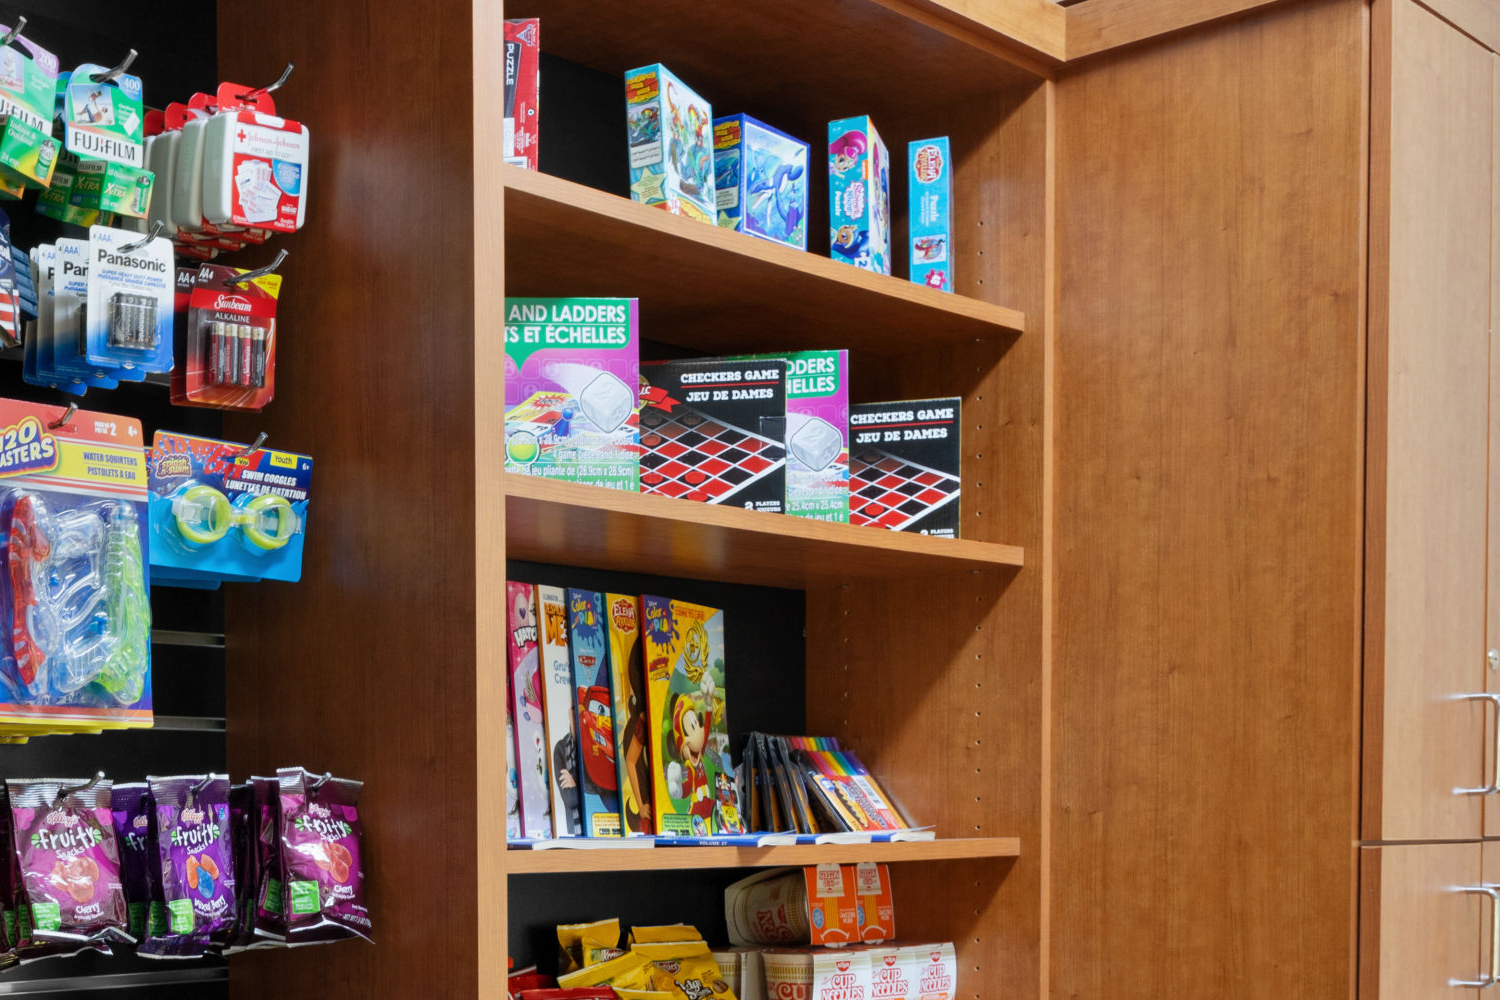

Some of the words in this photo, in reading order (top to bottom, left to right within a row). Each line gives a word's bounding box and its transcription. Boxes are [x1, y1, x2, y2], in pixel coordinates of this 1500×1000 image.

[38, 52, 57, 69] 200
[505, 43, 515, 86] PUZZLE
[123, 77, 140, 91] 400
[74, 131, 136, 161] FUJIFILM
[98, 233, 112, 243] AAA
[64, 245, 78, 255] AAA
[97, 249, 166, 273] Panasonic
[214, 295, 252, 312] Sunbeam
[215, 313, 250, 323] ALKALINE
[509, 305, 547, 321] AND
[552, 305, 626, 323] LADDERS
[524, 326, 541, 343] ET
[546, 323, 626, 344] ÉCHELLES
[681, 371, 741, 384] CHECKERS
[745, 369, 779, 380] GAME
[686, 391, 709, 402] JEU
[713, 390, 728, 401] DE
[732, 389, 773, 399] DAMES
[850, 412, 914, 425] CHECKERS
[917, 408, 954, 419] GAME
[856, 433, 881, 443] JEU
[884, 432, 900, 441] DE
[904, 428, 948, 440] DAMES
[83, 452, 105, 462] WATER
[106, 454, 138, 466] SQUIRTERS
[275, 455, 292, 465] Youth
[242, 470, 264, 480] SWIM
[264, 473, 297, 486] GOGGLES
[226, 480, 260, 493] LUNETTES
[261, 485, 270, 493] DE
[271, 487, 307, 500] NATATION
[572, 597, 586, 612] Color
[613, 604, 636, 618] ELENA
[646, 605, 662, 618] Color
[39, 827, 96, 849] fruity
[176, 822, 214, 846] fruity
[76, 903, 100, 913] Cherry
[879, 968, 901, 984] CUP
[928, 964, 945, 979] CUP
[831, 974, 855, 989] CUP
[872, 980, 908, 998] NOODLES
[920, 976, 950, 994] NOODLES
